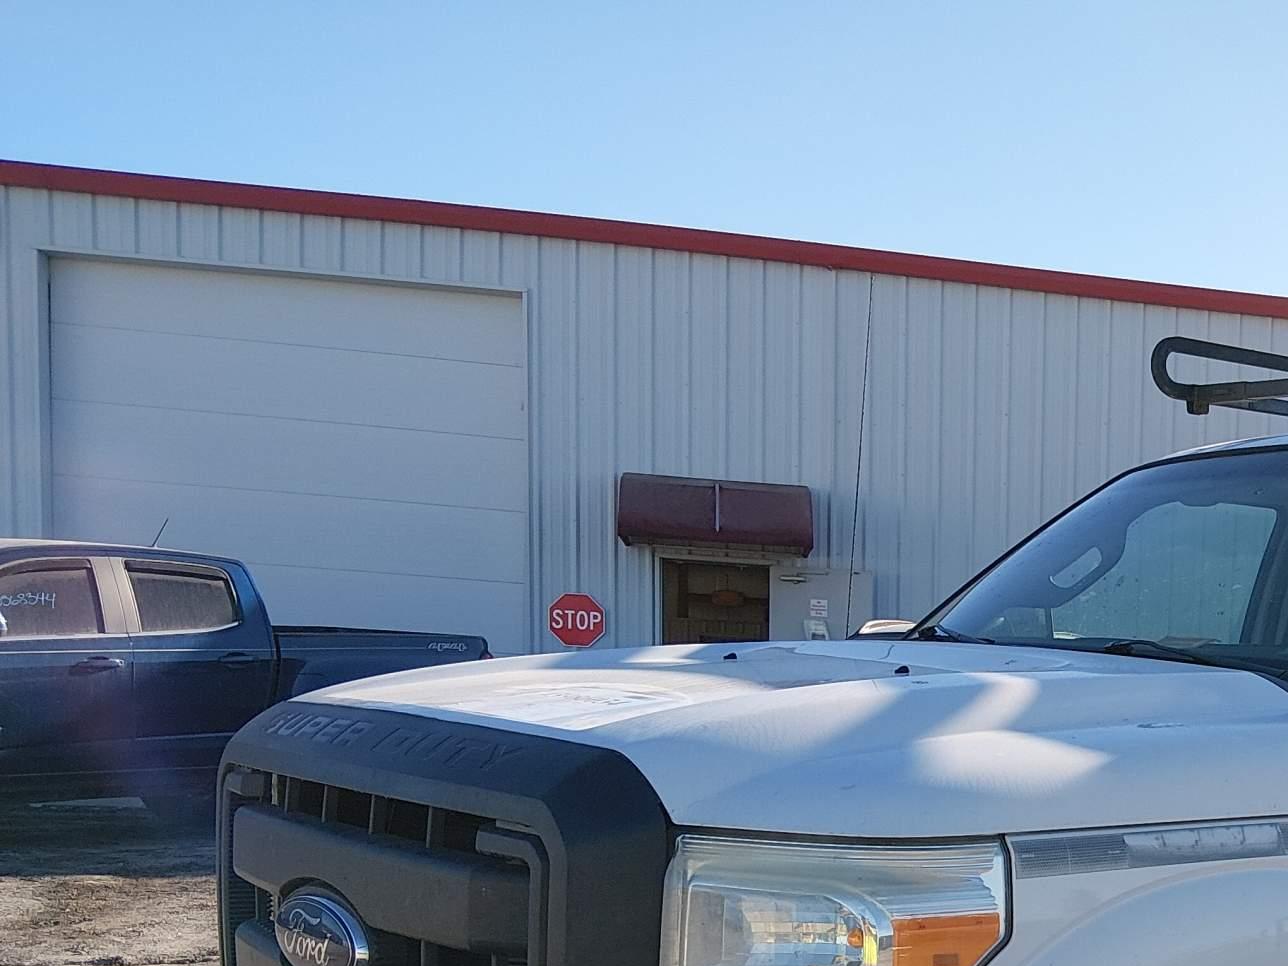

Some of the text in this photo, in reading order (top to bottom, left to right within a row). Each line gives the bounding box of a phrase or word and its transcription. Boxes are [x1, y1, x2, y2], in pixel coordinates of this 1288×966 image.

[551, 609, 602, 631] STOP
[266, 710, 522, 772] SUPER DUTY
